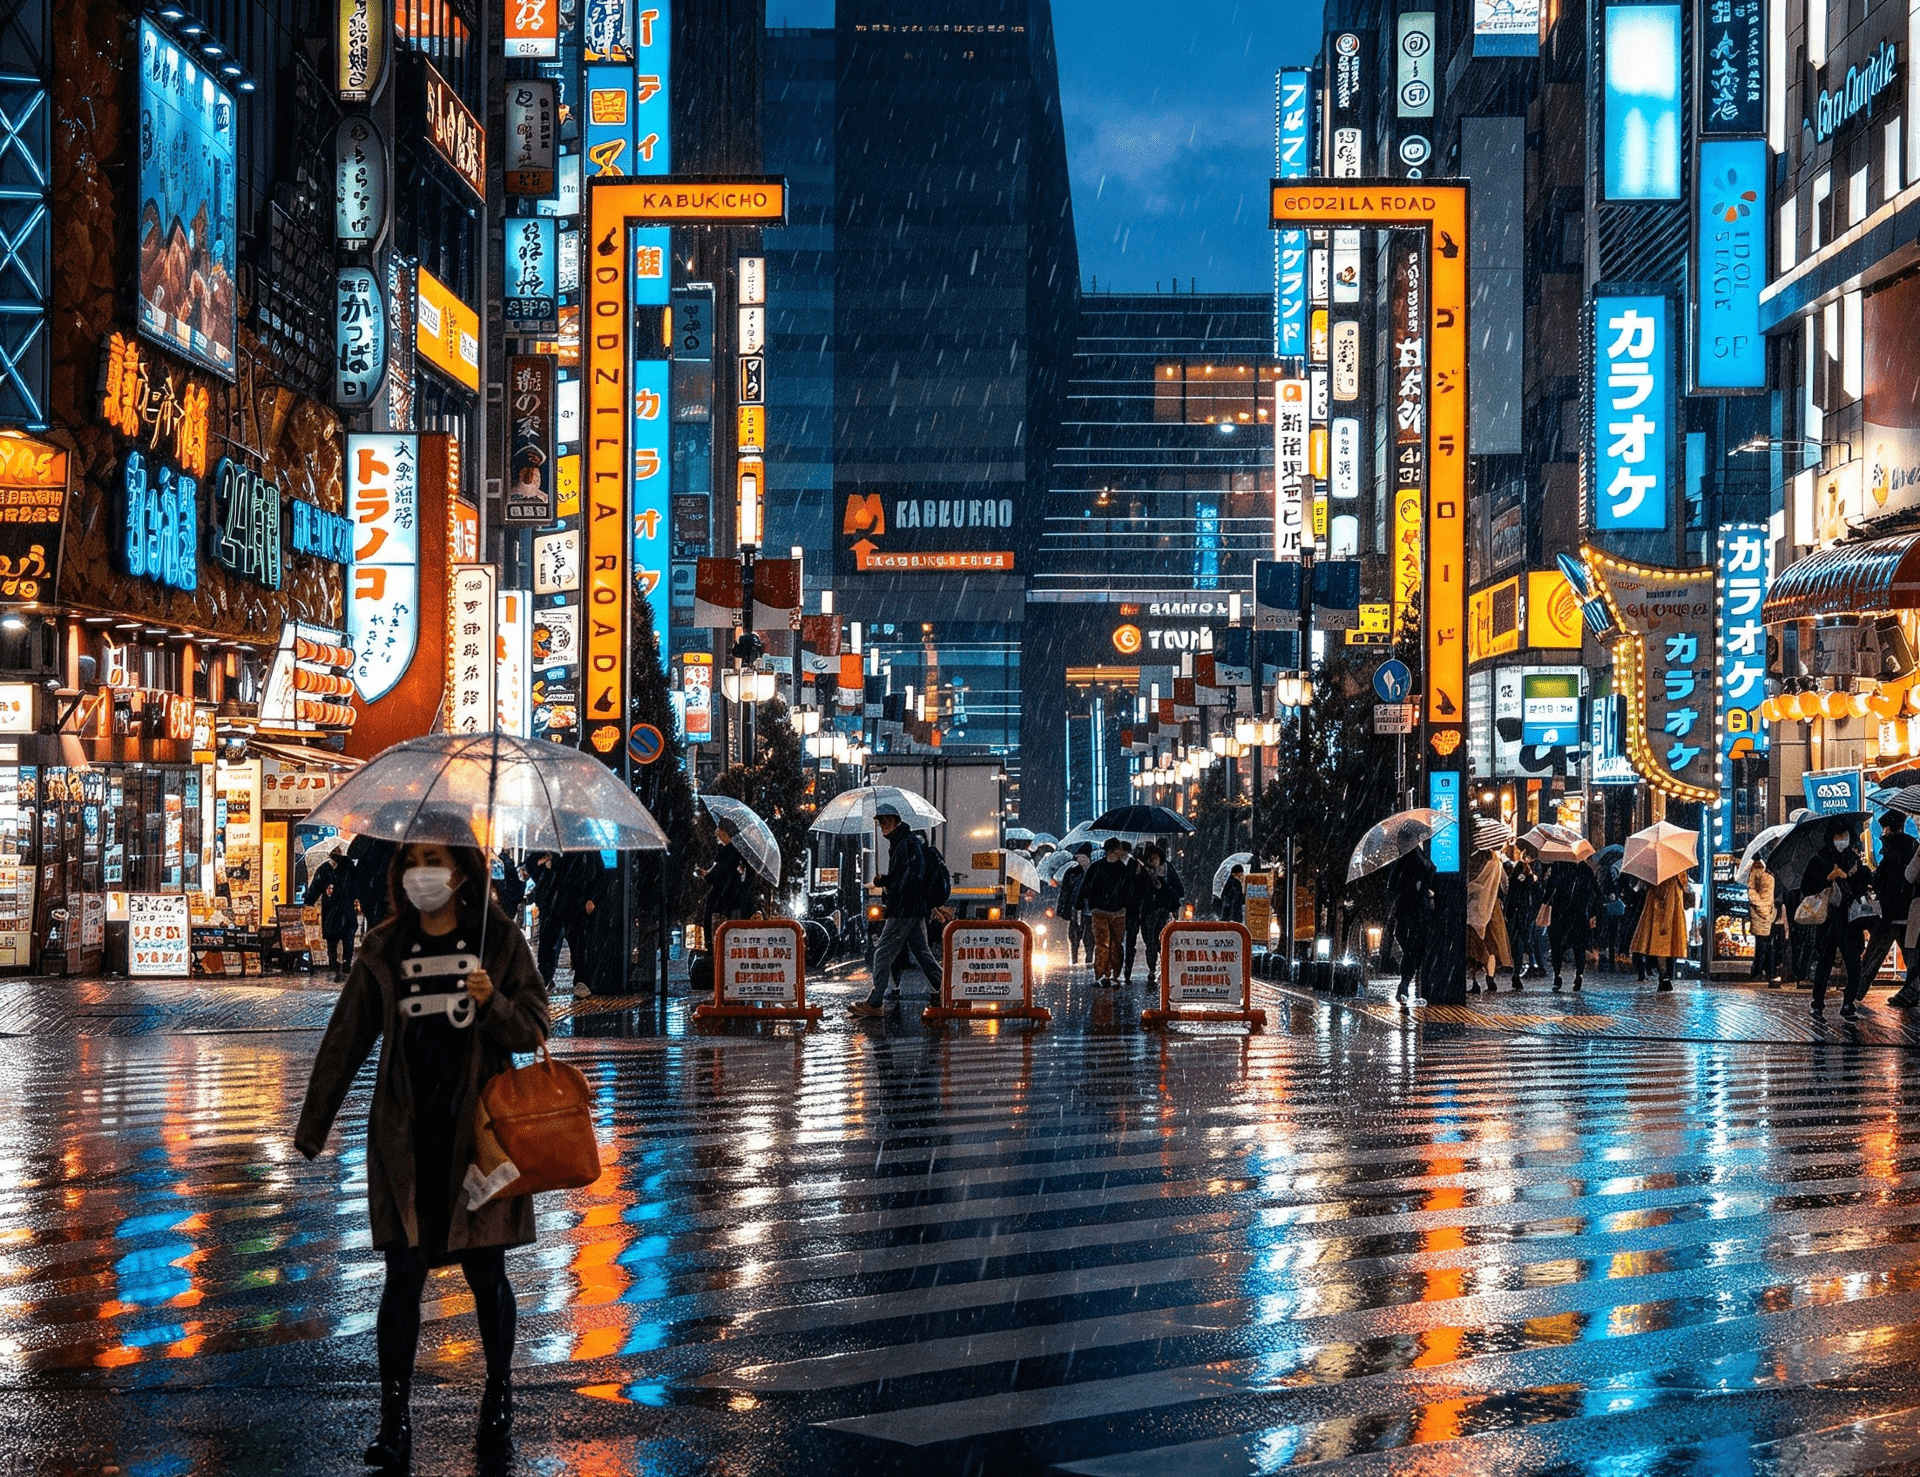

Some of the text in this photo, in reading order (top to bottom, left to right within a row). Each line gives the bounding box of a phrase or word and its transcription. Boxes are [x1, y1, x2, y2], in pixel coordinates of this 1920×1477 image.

[643, 192, 767, 208] KABUKICHO
[1381, 197, 1436, 211] ROAD
[1606, 309, 1657, 518] カラオケ
[355, 449, 389, 600] トラノコ
[593, 555, 617, 673] ROAD
[1726, 536, 1764, 698] カラオケ
[1664, 633, 1700, 771] カラオケ
